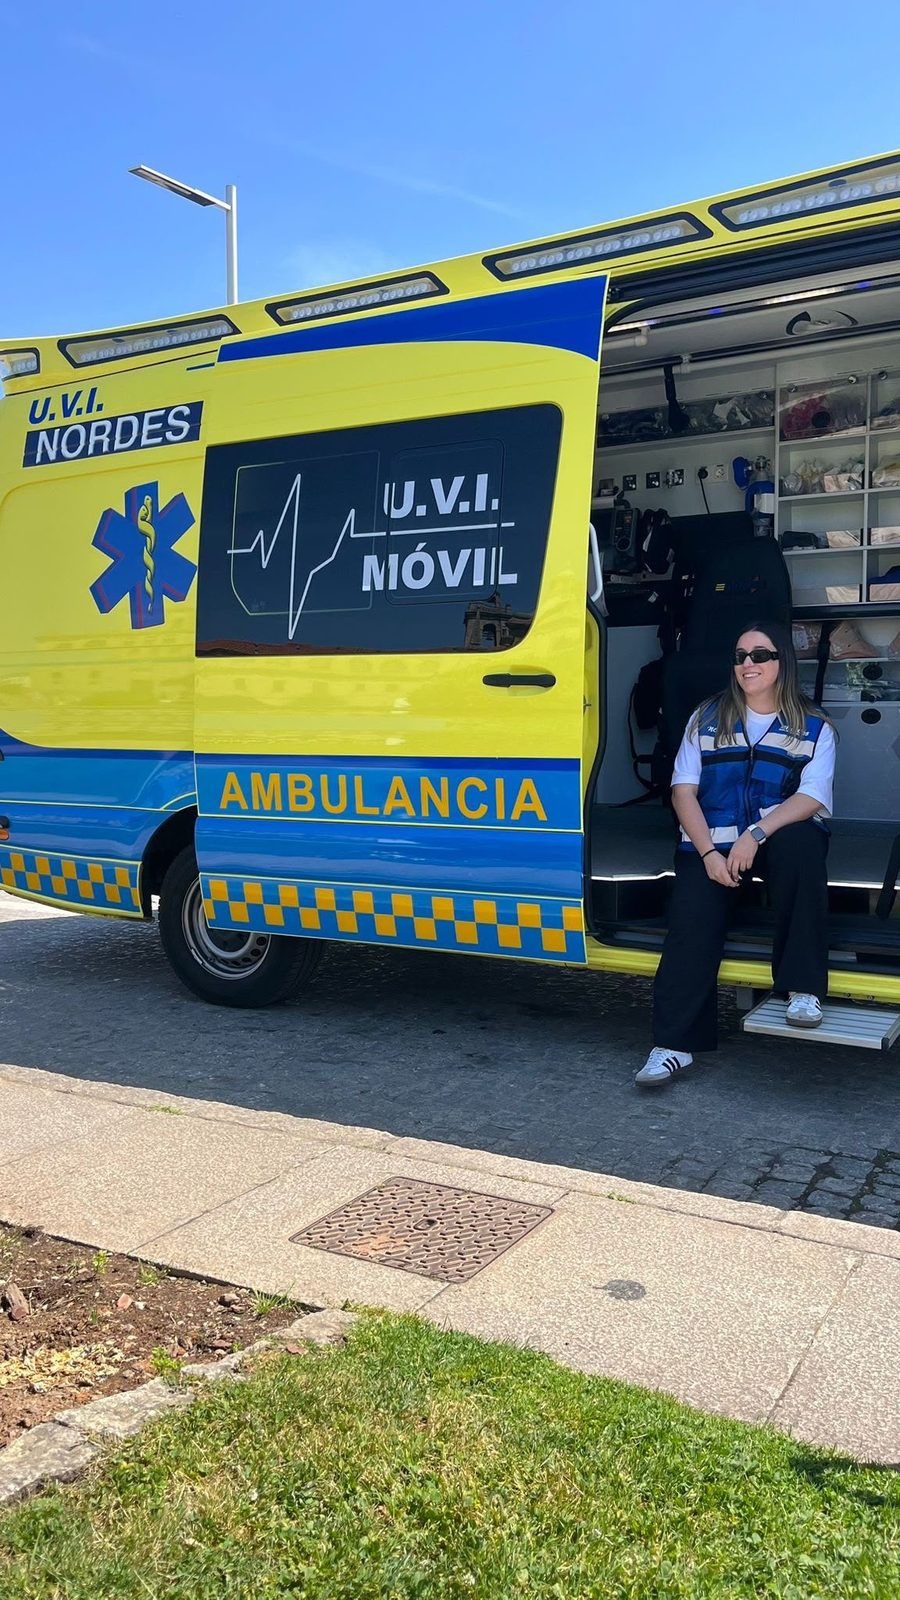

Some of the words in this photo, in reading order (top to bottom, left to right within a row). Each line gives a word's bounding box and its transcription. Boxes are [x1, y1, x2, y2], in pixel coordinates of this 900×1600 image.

[29, 387, 104, 424] U.V.I.
[35, 405, 191, 464] NORDES
[383, 473, 499, 518] U.V.I.
[362, 542, 518, 591] MÓVIL
[219, 771, 548, 821] AMBULANCIA
